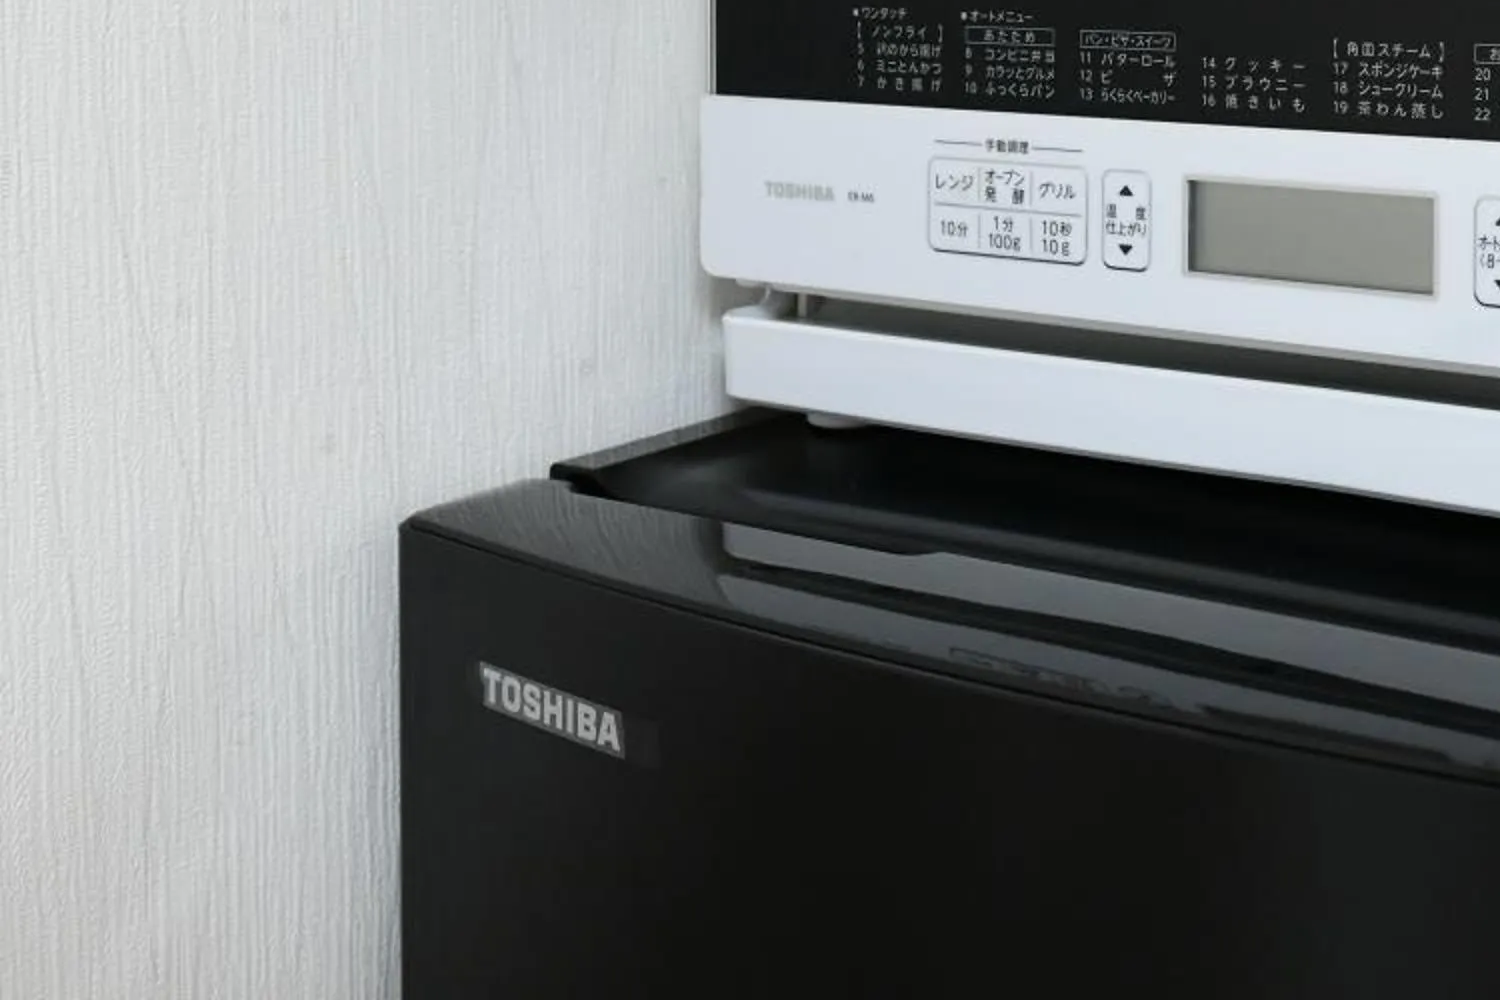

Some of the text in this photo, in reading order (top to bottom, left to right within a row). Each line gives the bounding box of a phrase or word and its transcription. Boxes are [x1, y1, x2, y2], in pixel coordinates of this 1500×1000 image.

[1080, 51, 1091, 64] 11
[1201, 57, 1216, 69] 14
[1080, 69, 1092, 82] 12
[1332, 61, 1444, 80] 17 スポンジケーキ
[1474, 67, 1491, 81] 20
[1201, 75, 1217, 88] 15
[1333, 80, 1444, 99] 18 シュークリーム
[1080, 88, 1094, 101] 13
[1474, 87, 1489, 101] 21
[1333, 100, 1349, 114] 19
[1474, 107, 1491, 121] 22
[764, 180, 834, 201] TOSHIBA
[935, 173, 974, 191] レンジ
[1039, 183, 1076, 200] グリル
[940, 220, 968, 237] 10分
[993, 215, 1013, 233] 1分
[1042, 220, 1072, 237] 10秒
[1105, 220, 1147, 238] 仕上がり
[989, 234, 1021, 252] 100g
[483, 667, 621, 752] TOSHIBA
